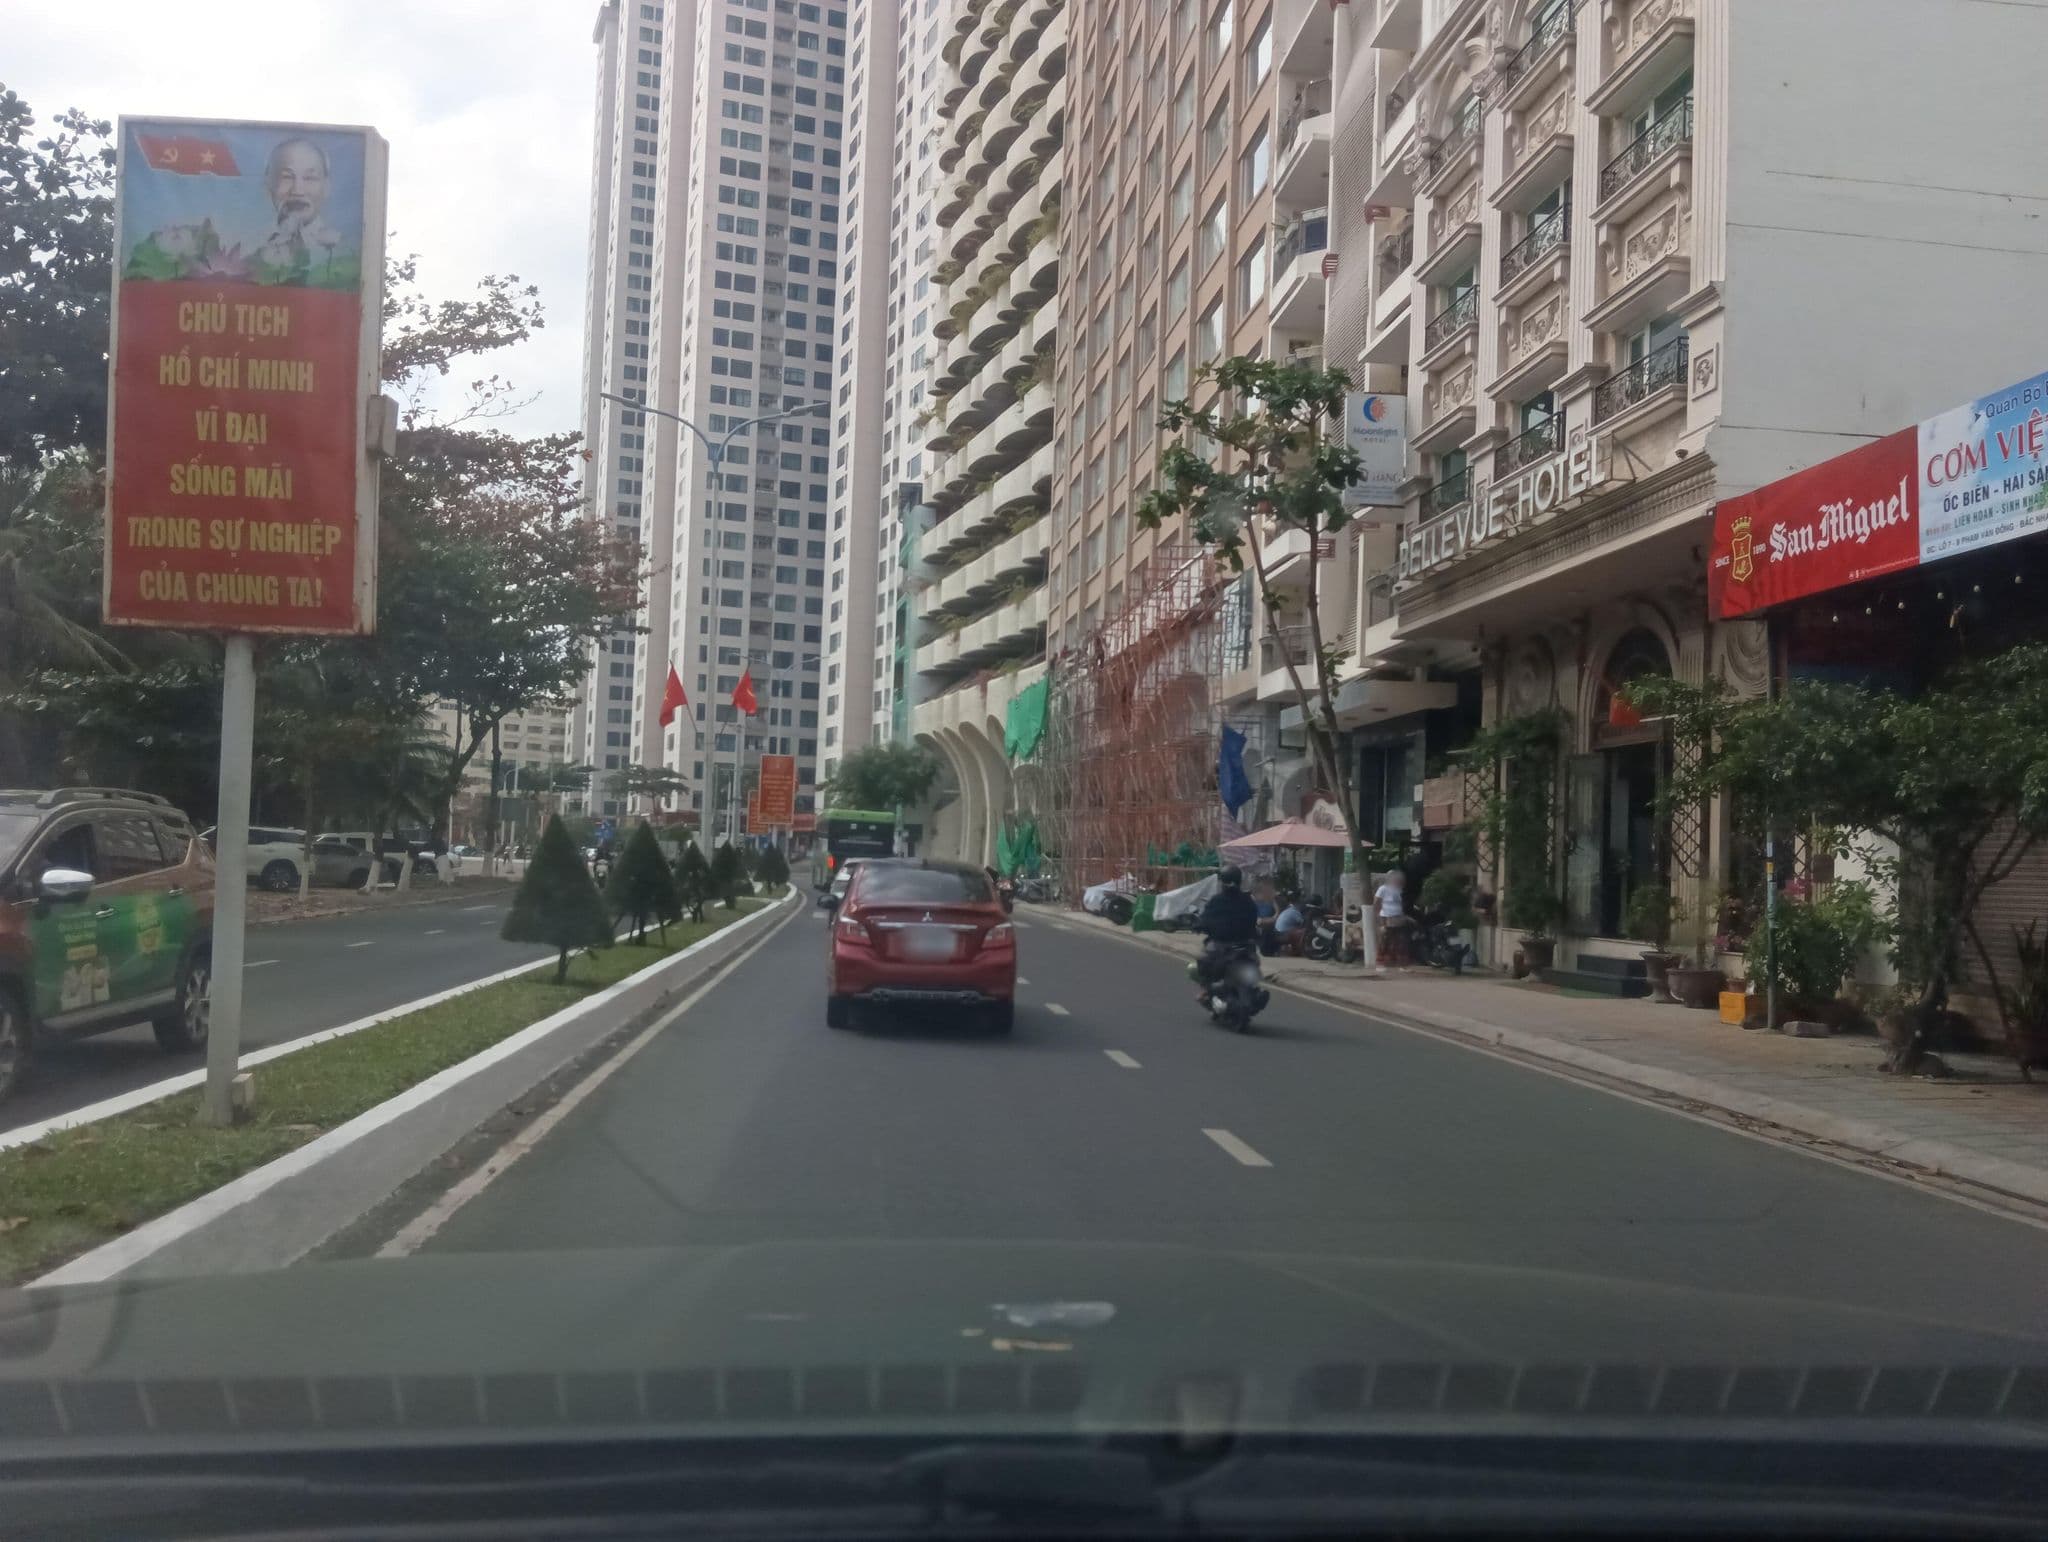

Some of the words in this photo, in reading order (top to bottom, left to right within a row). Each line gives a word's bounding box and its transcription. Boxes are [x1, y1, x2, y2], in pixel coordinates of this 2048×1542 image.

[178, 292, 227, 334] CHỦ
[235, 303, 290, 342] TỊCH
[159, 344, 192, 386] HỒ
[199, 351, 241, 389] CHÍ
[248, 360, 314, 393] MINH
[195, 405, 218, 441] VĨ
[225, 412, 268, 451] ĐẠI
[1927, 439, 1987, 487] CƠM
[1996, 407, 2048, 463] VIỆ
[170, 453, 237, 497] SỐNG
[244, 462, 293, 500] MÃI
[1943, 491, 1959, 513] ỐC
[1963, 481, 1990, 507] BIỂN
[2003, 471, 2024, 494] HẢI
[1399, 487, 1505, 579] BELLEVUE
[1518, 435, 1605, 523] HOTEL
[1769, 520, 1815, 563] San
[1816, 474, 1911, 550] Miguel
[127, 517, 201, 550] TRONG
[209, 517, 245, 558] SỰ
[249, 518, 342, 562] NGHIỆP
[139, 560, 189, 602] CỦA
[196, 566, 279, 606] CHÚNG
[286, 577, 323, 608] TA!
